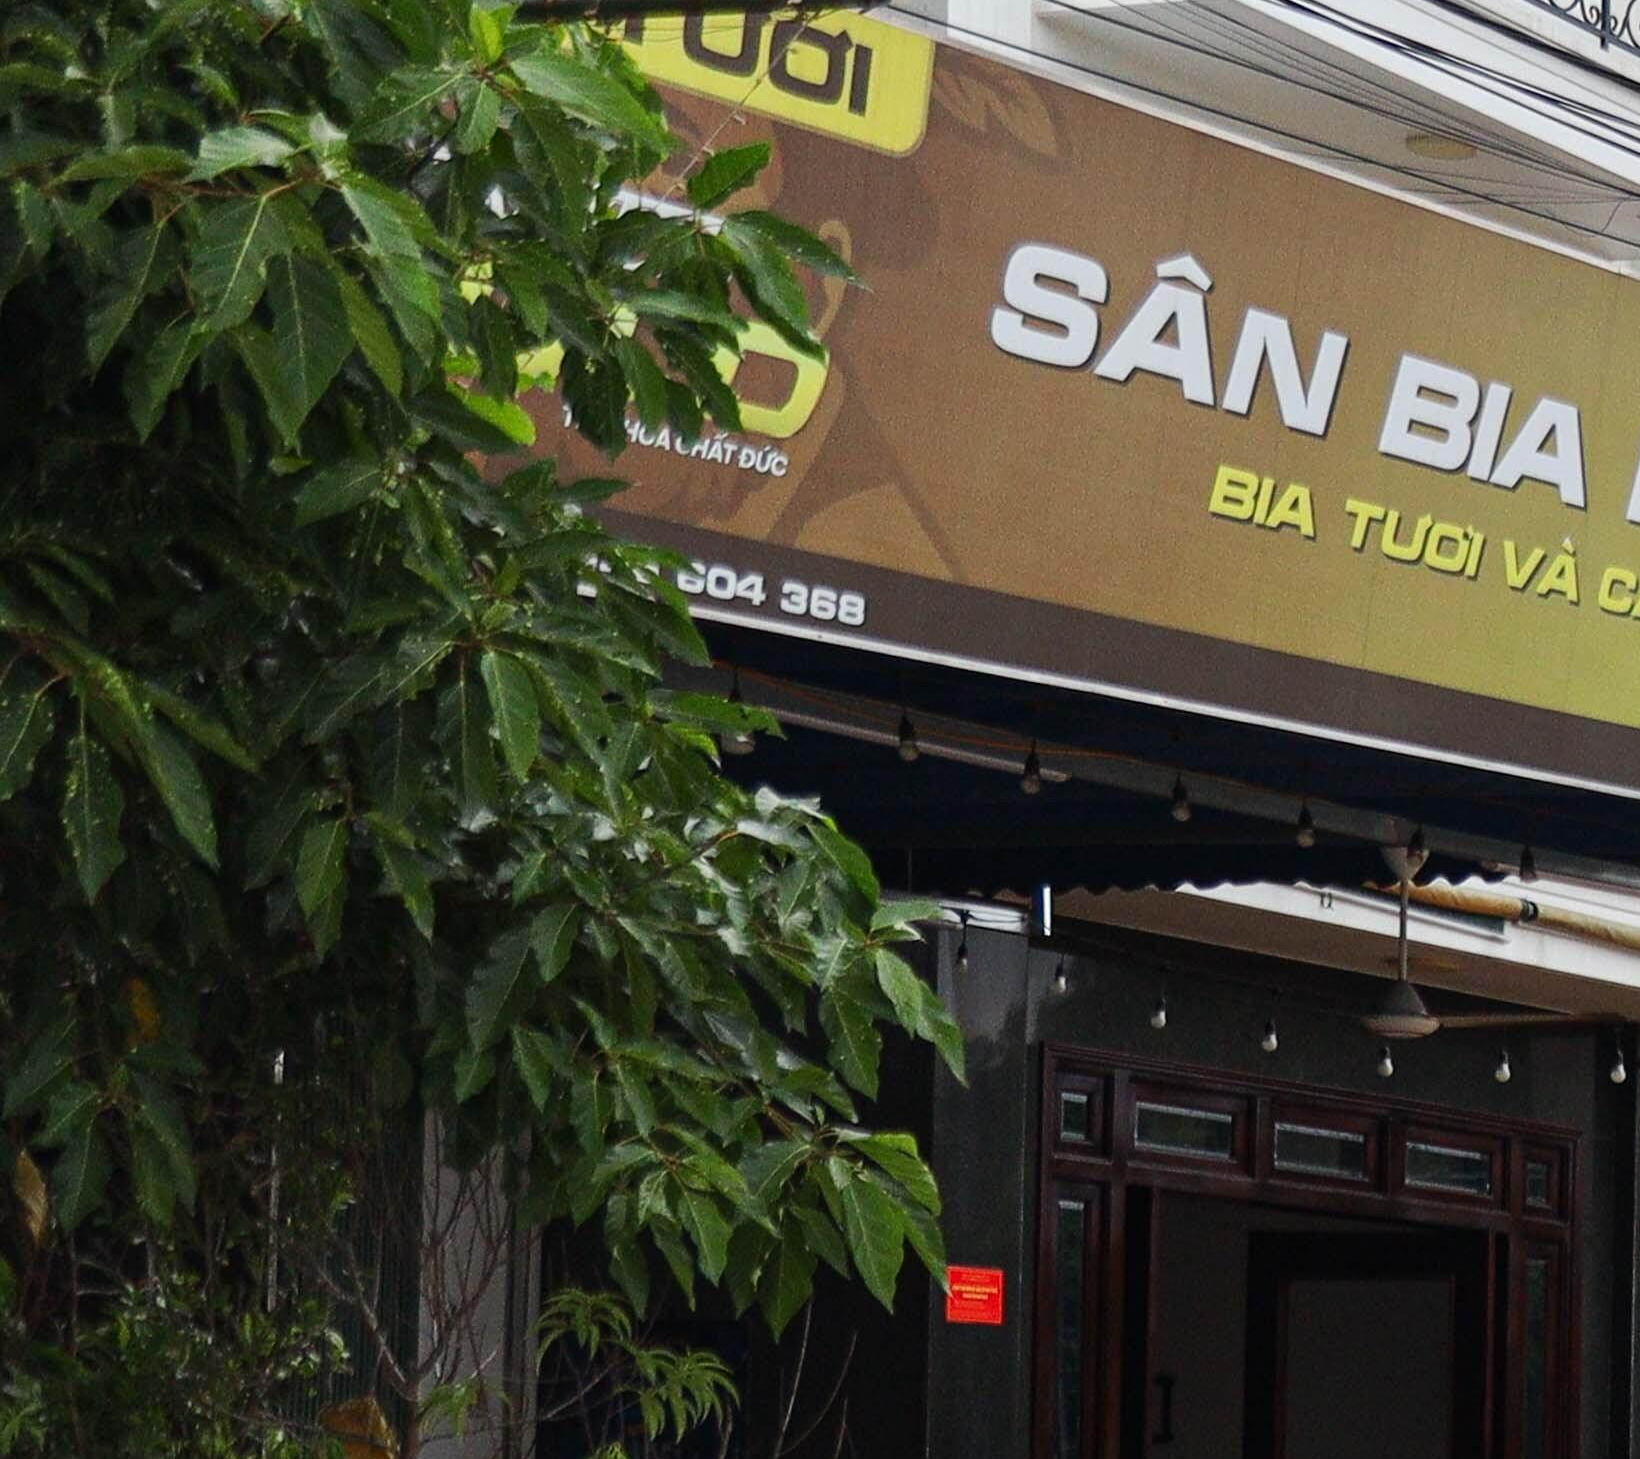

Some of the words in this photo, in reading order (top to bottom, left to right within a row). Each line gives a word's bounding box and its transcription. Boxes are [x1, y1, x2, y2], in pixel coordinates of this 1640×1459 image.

[990, 244, 1350, 437] SÂN
[1378, 353, 1588, 509] BIA
[738, 446, 788, 477] ĐỨC
[1207, 464, 1316, 539] BIA
[1344, 498, 1486, 580] TƯƠI
[1502, 535, 1580, 605] VÀ
[676, 560, 767, 607] 604
[780, 580, 865, 626] 368
